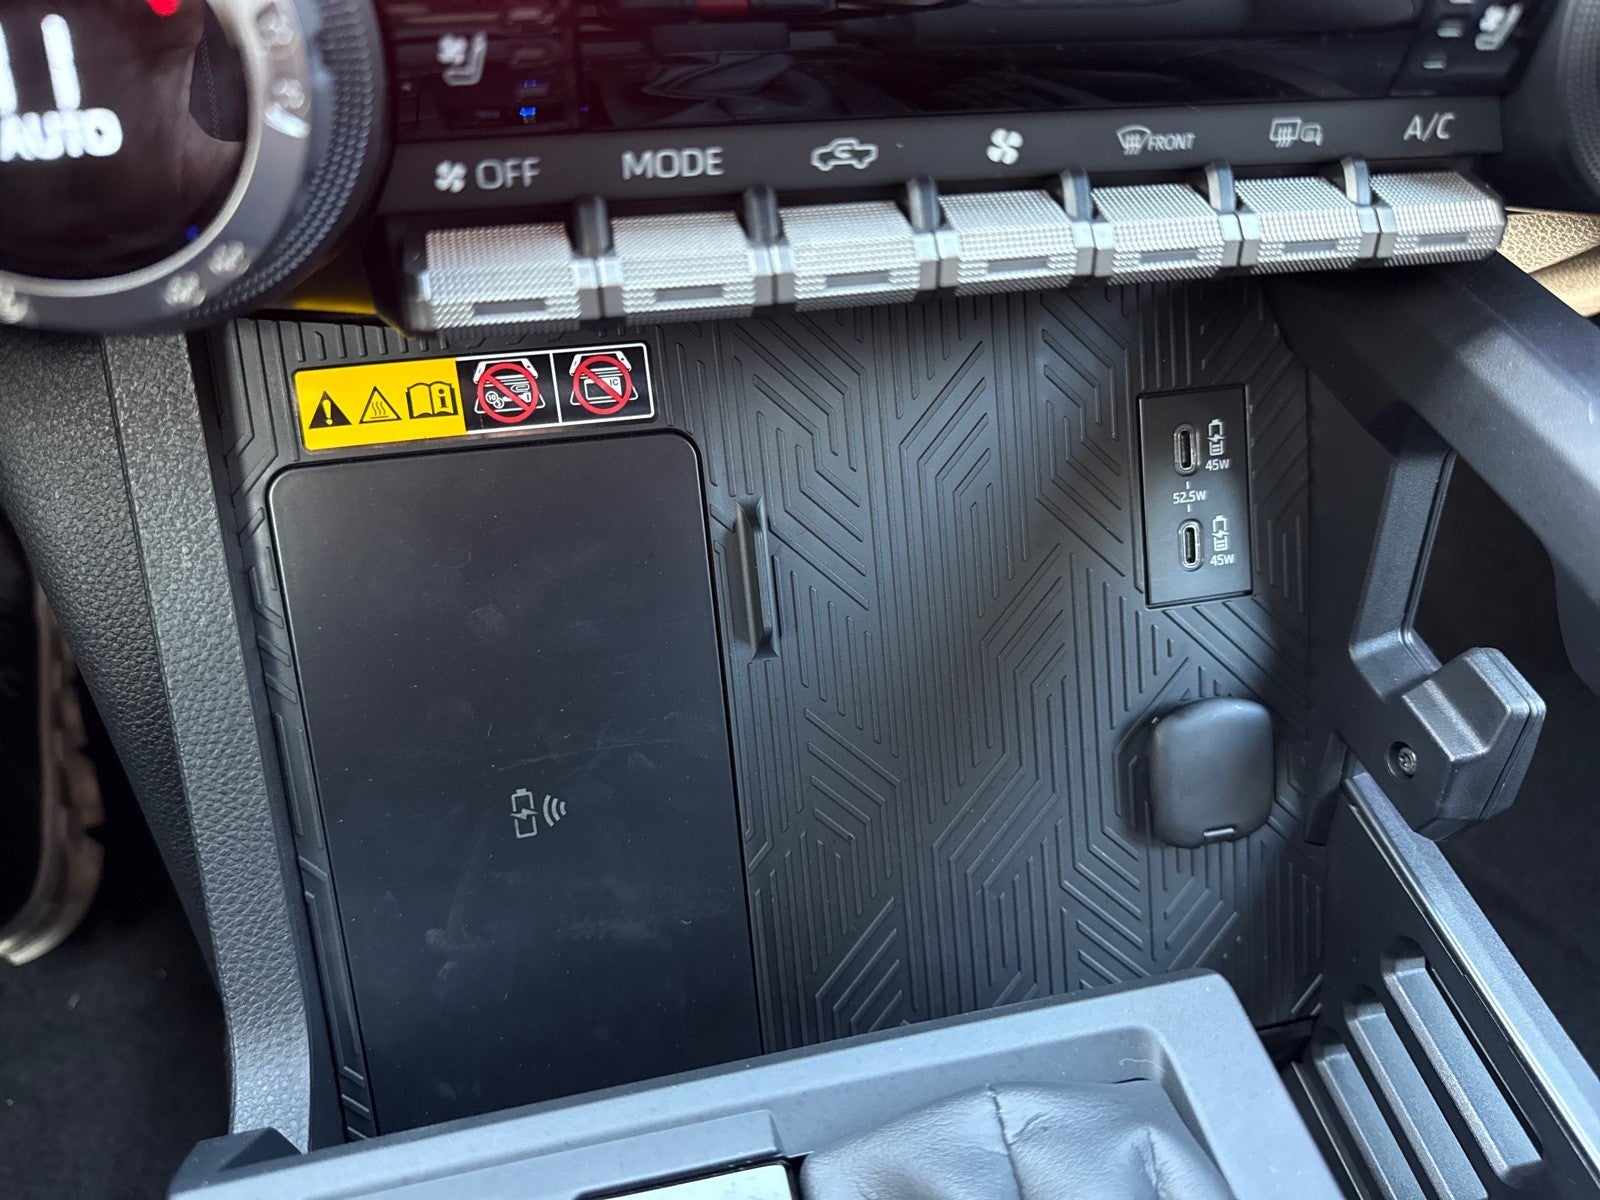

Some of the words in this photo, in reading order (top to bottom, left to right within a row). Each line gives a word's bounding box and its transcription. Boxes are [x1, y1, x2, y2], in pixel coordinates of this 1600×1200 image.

[1403, 112, 1454, 142] A/C
[1148, 132, 1196, 151] FRONT
[621, 146, 725, 180] MODE
[474, 156, 541, 190] OFF
[1204, 458, 1231, 472] 45W
[1172, 490, 1207, 505] 52.5W
[1209, 553, 1236, 567] 45W
